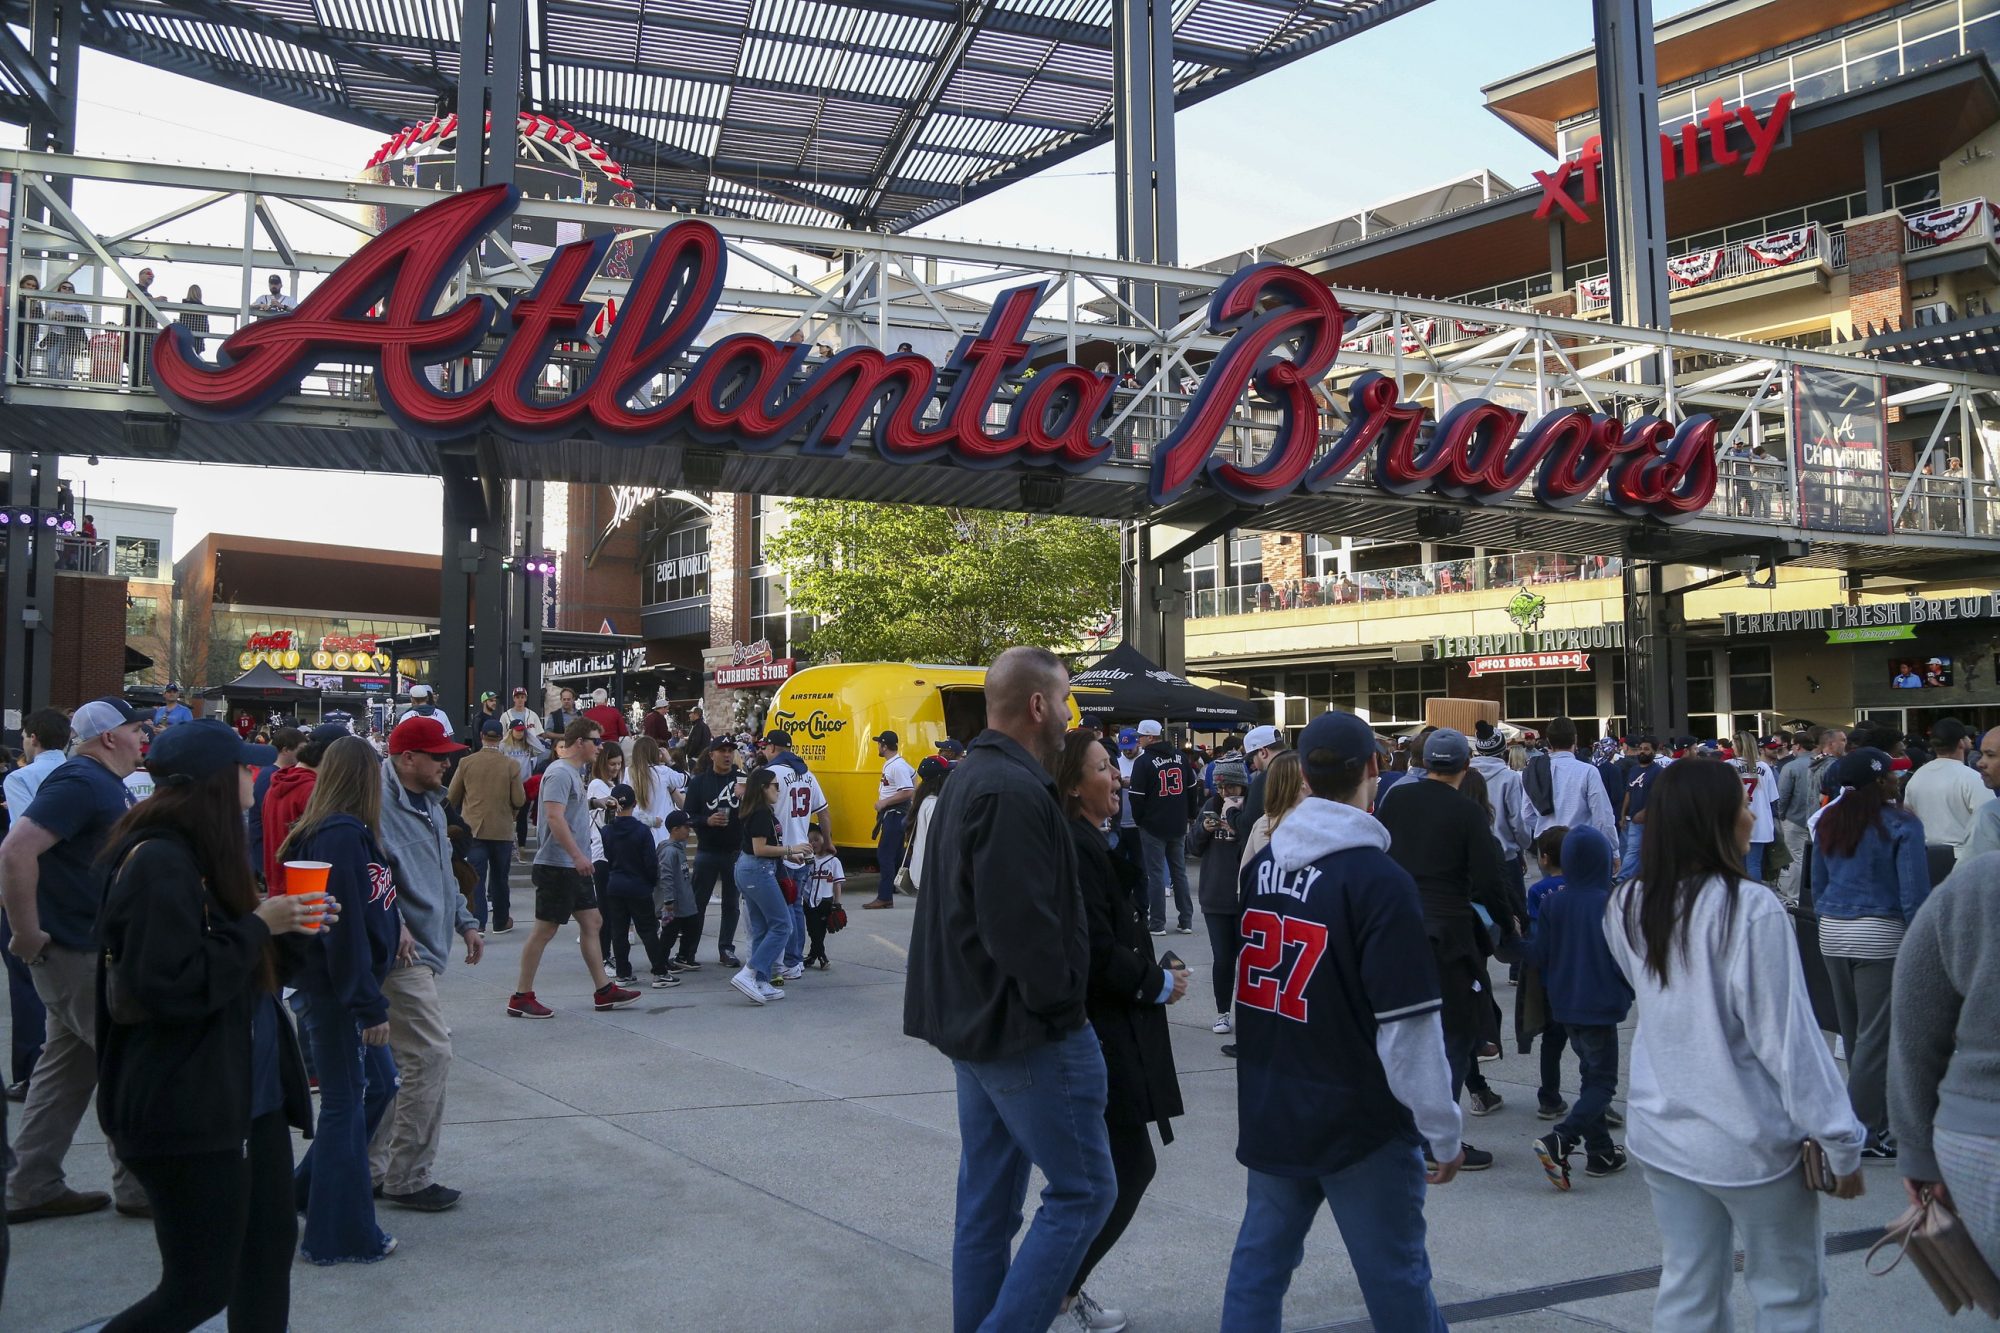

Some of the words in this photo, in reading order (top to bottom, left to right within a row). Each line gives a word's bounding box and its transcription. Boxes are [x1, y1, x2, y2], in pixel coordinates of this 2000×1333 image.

[1532, 91, 1796, 224] xfity
[150, 183, 1120, 473] Atlanta
[1149, 262, 1720, 523] Braves
[1803, 443, 1883, 471] CHAMPIONS
[657, 560, 677, 582] 2021
[678, 554, 710, 578] WORLD
[1719, 609, 1825, 636] TERRAPIN
[1830, 603, 1902, 629] FRESH
[1908, 596, 1982, 623] BREW
[1429, 631, 1526, 660] TERRAPIN
[1531, 621, 1625, 652] TAPROOM
[553, 658, 582, 676] RIGHT
[584, 654, 615, 672] FIELD
[622, 647, 647, 668] ATE
[717, 667, 760, 684] CLUBHOUSE
[762, 664, 789, 680] STORE
[1488, 659, 1505, 669] FOX
[1509, 657, 1537, 668] BROS.
[1539, 654, 1580, 666] BAR-B-Q
[790, 692, 834, 700] AIRSTREAM
[774, 711, 808, 736] Topo
[808, 710, 847, 740] Chico
[791, 745, 800, 755] RD
[802, 745, 826, 755] SELTZER
[1159, 768, 1184, 797] 13
[789, 787, 811, 818] 13
[1257, 859, 1323, 903] RILEY
[1236, 908, 1329, 1024] 27
